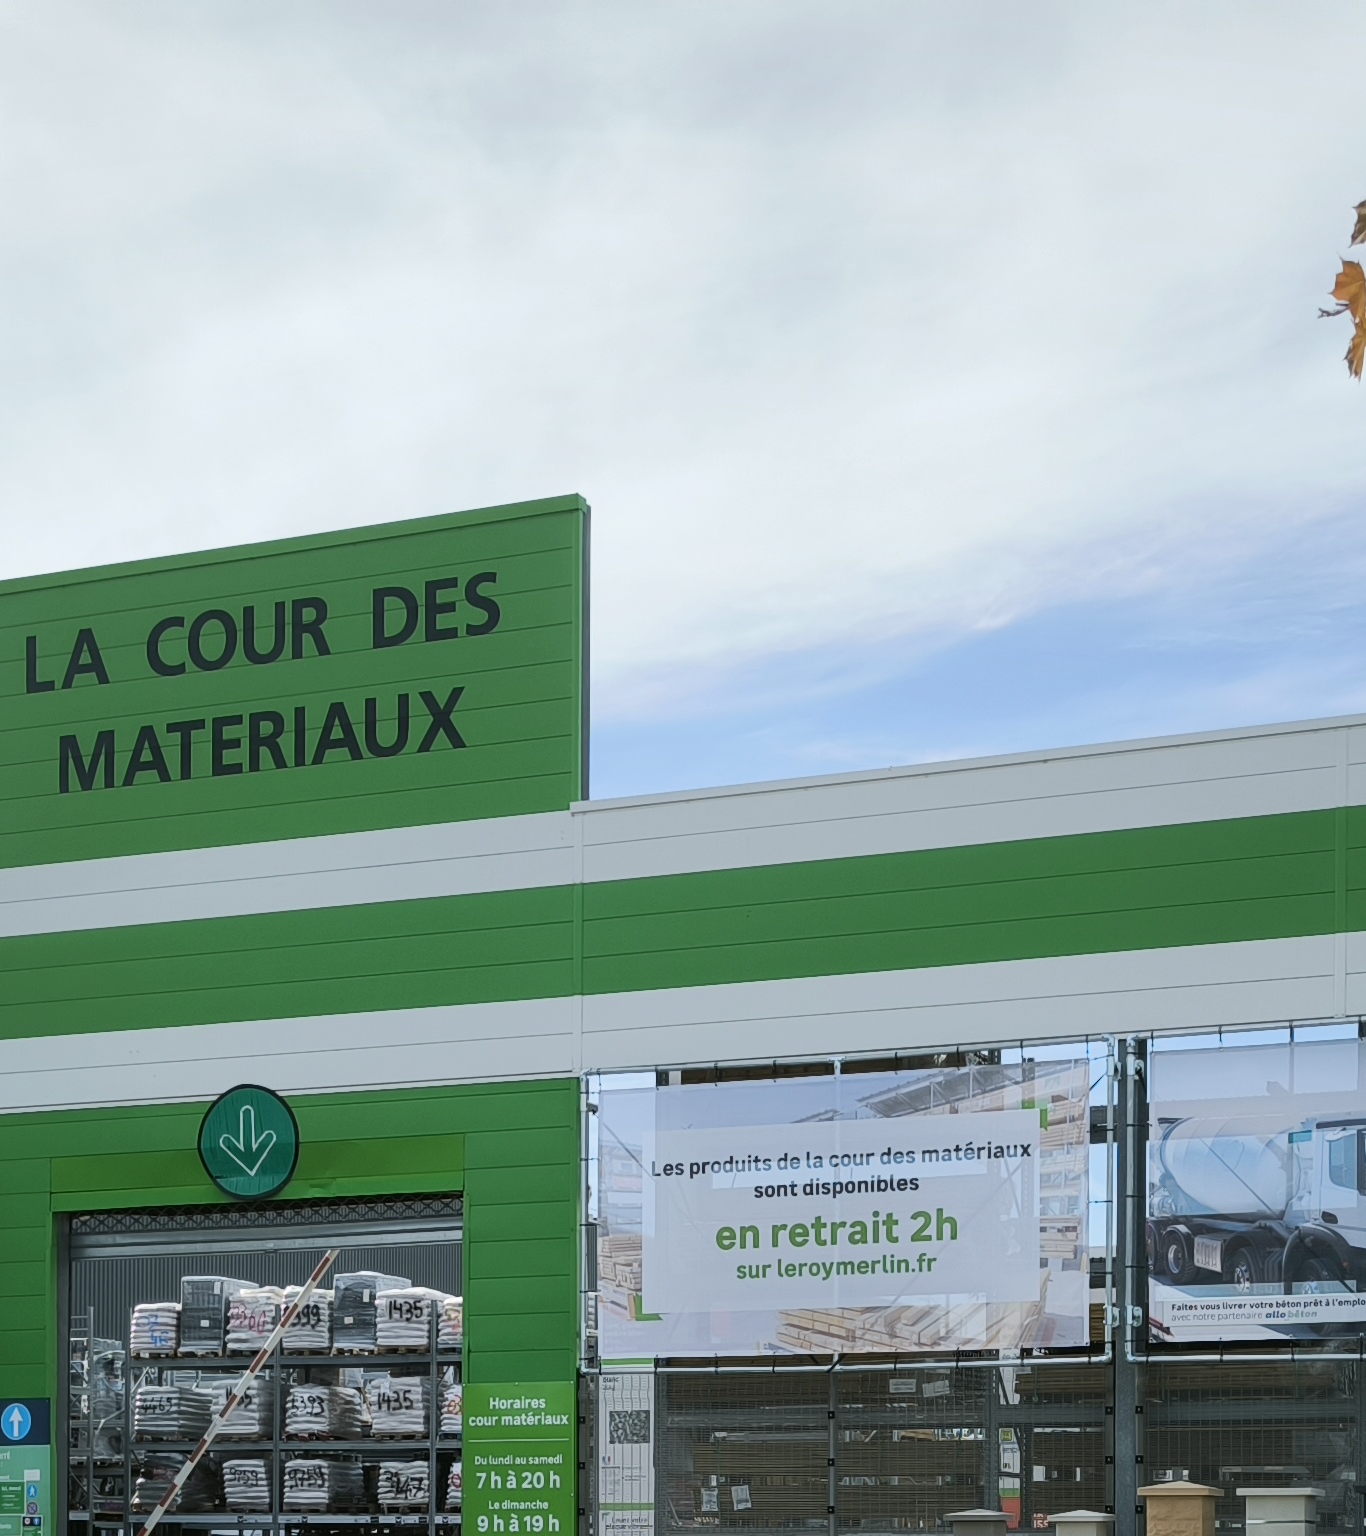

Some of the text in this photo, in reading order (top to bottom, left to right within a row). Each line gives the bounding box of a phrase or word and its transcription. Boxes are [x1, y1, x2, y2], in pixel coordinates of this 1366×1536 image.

[25, 572, 501, 694] LA COUR DES
[58, 686, 467, 794] MATERIAUX
[651, 1141, 1032, 1179] Les produits de la cour des matériaux
[754, 1174, 920, 1199] sont disponibles
[716, 1208, 958, 1250] en retrait 2h
[736, 1252, 937, 1281] sur leroymerlin.fr
[388, 1299, 423, 1322] 1435
[1171, 1303, 1198, 1311] Faites
[1222, 1301, 1247, 1310] livrer
[1249, 1301, 1274, 1309] votre
[1276, 1300, 1302, 1308] béton
[1303, 1298, 1323, 1308] prêt
[1193, 1311, 1263, 1321] notre partenaire
[377, 1389, 414, 1412] 1435
[489, 1396, 546, 1410] Horaires
[468, 1411, 569, 1427] cour matériaux
[474, 1454, 563, 1465] Du lundi au samedi
[476, 1470, 561, 1489] 7 h à 20 h
[489, 1499, 549, 1510] Le dimanche
[477, 1513, 560, 1532] 9 h à 19 h
